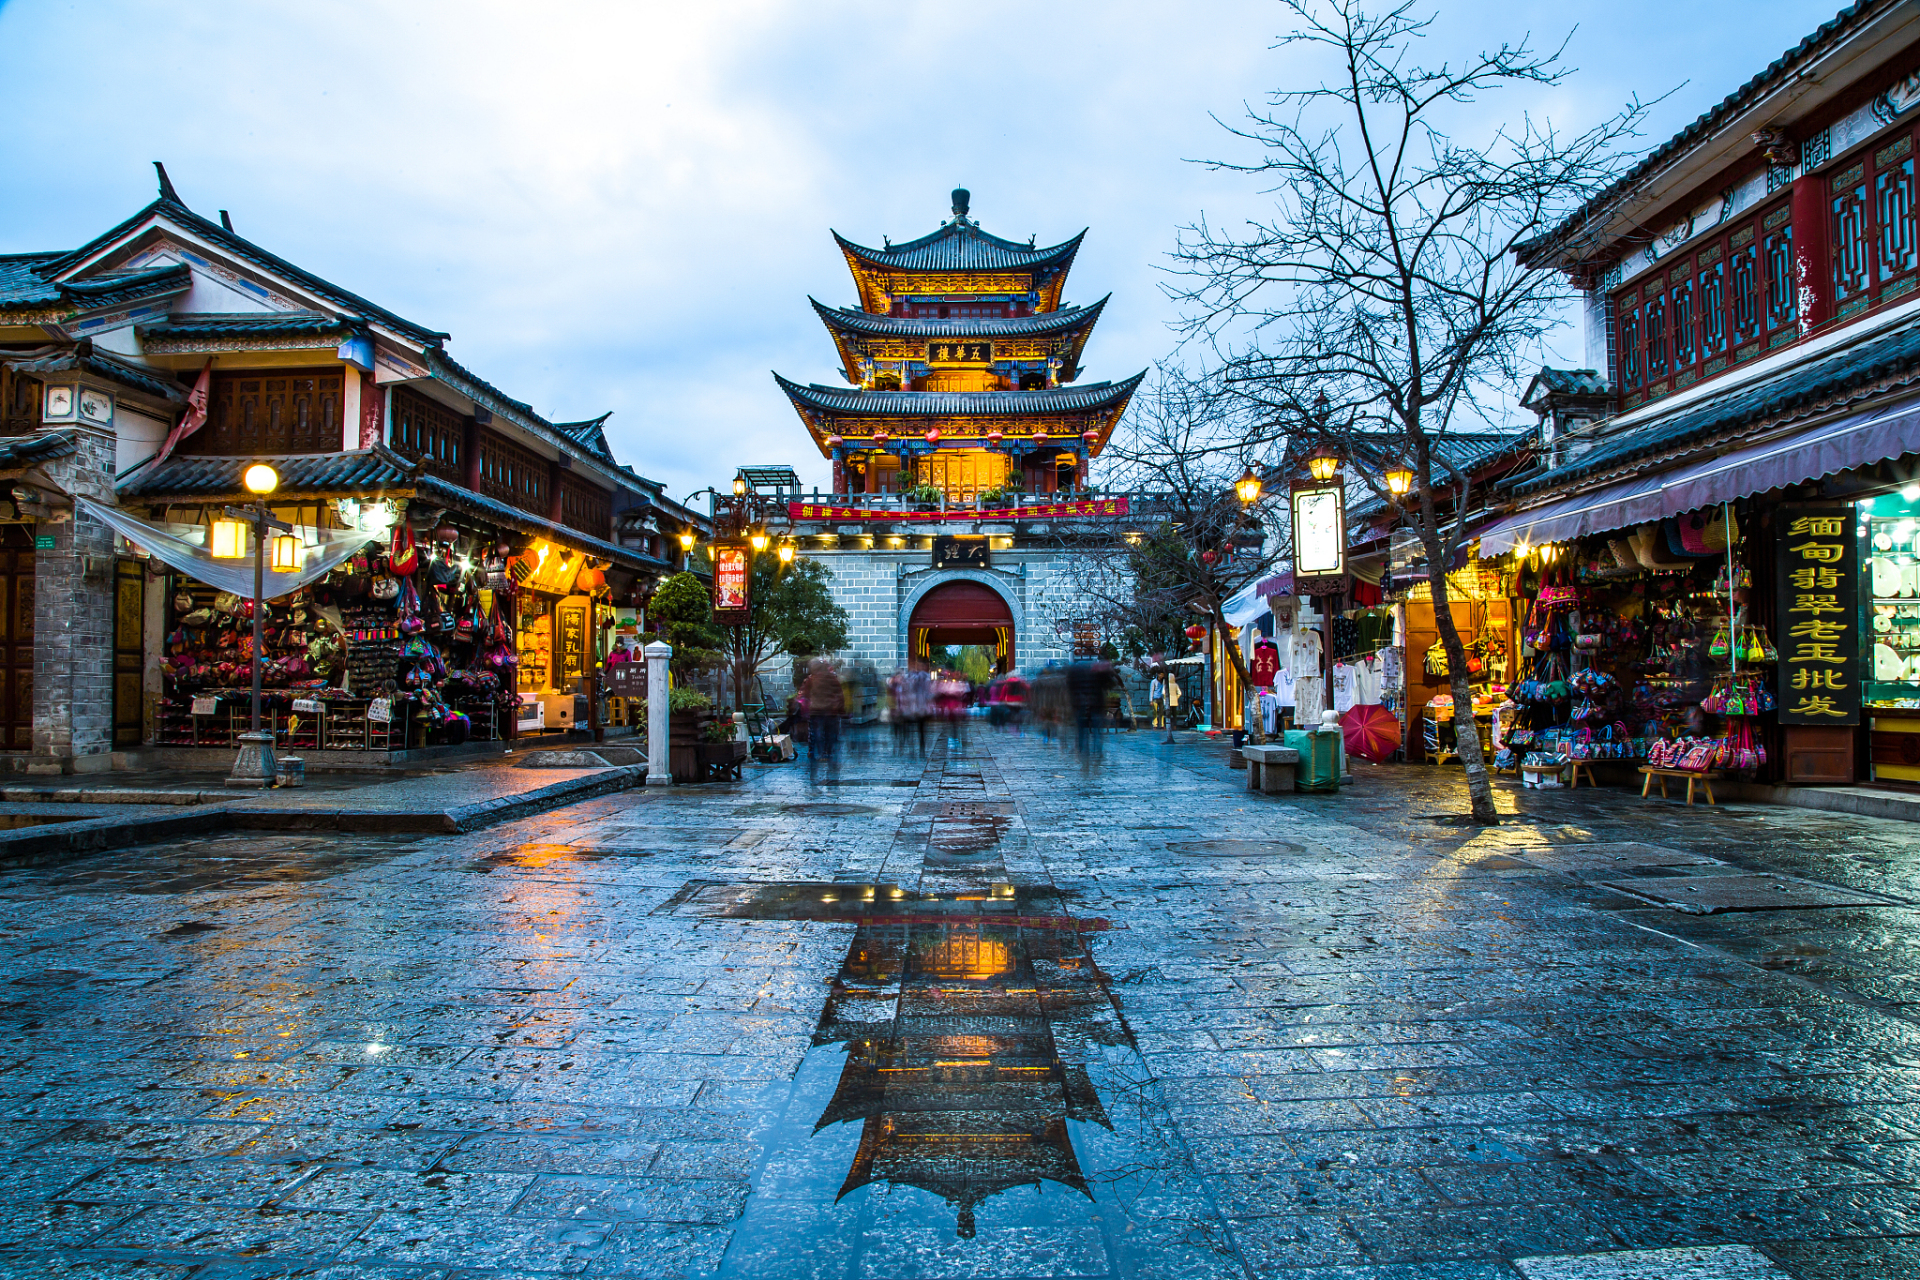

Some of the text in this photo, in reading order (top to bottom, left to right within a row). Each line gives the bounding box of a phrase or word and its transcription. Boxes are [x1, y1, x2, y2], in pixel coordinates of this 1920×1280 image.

[937, 345, 981, 361] 五華樓
[1787, 516, 1848, 717] 缅甸翡翠老玉批发
